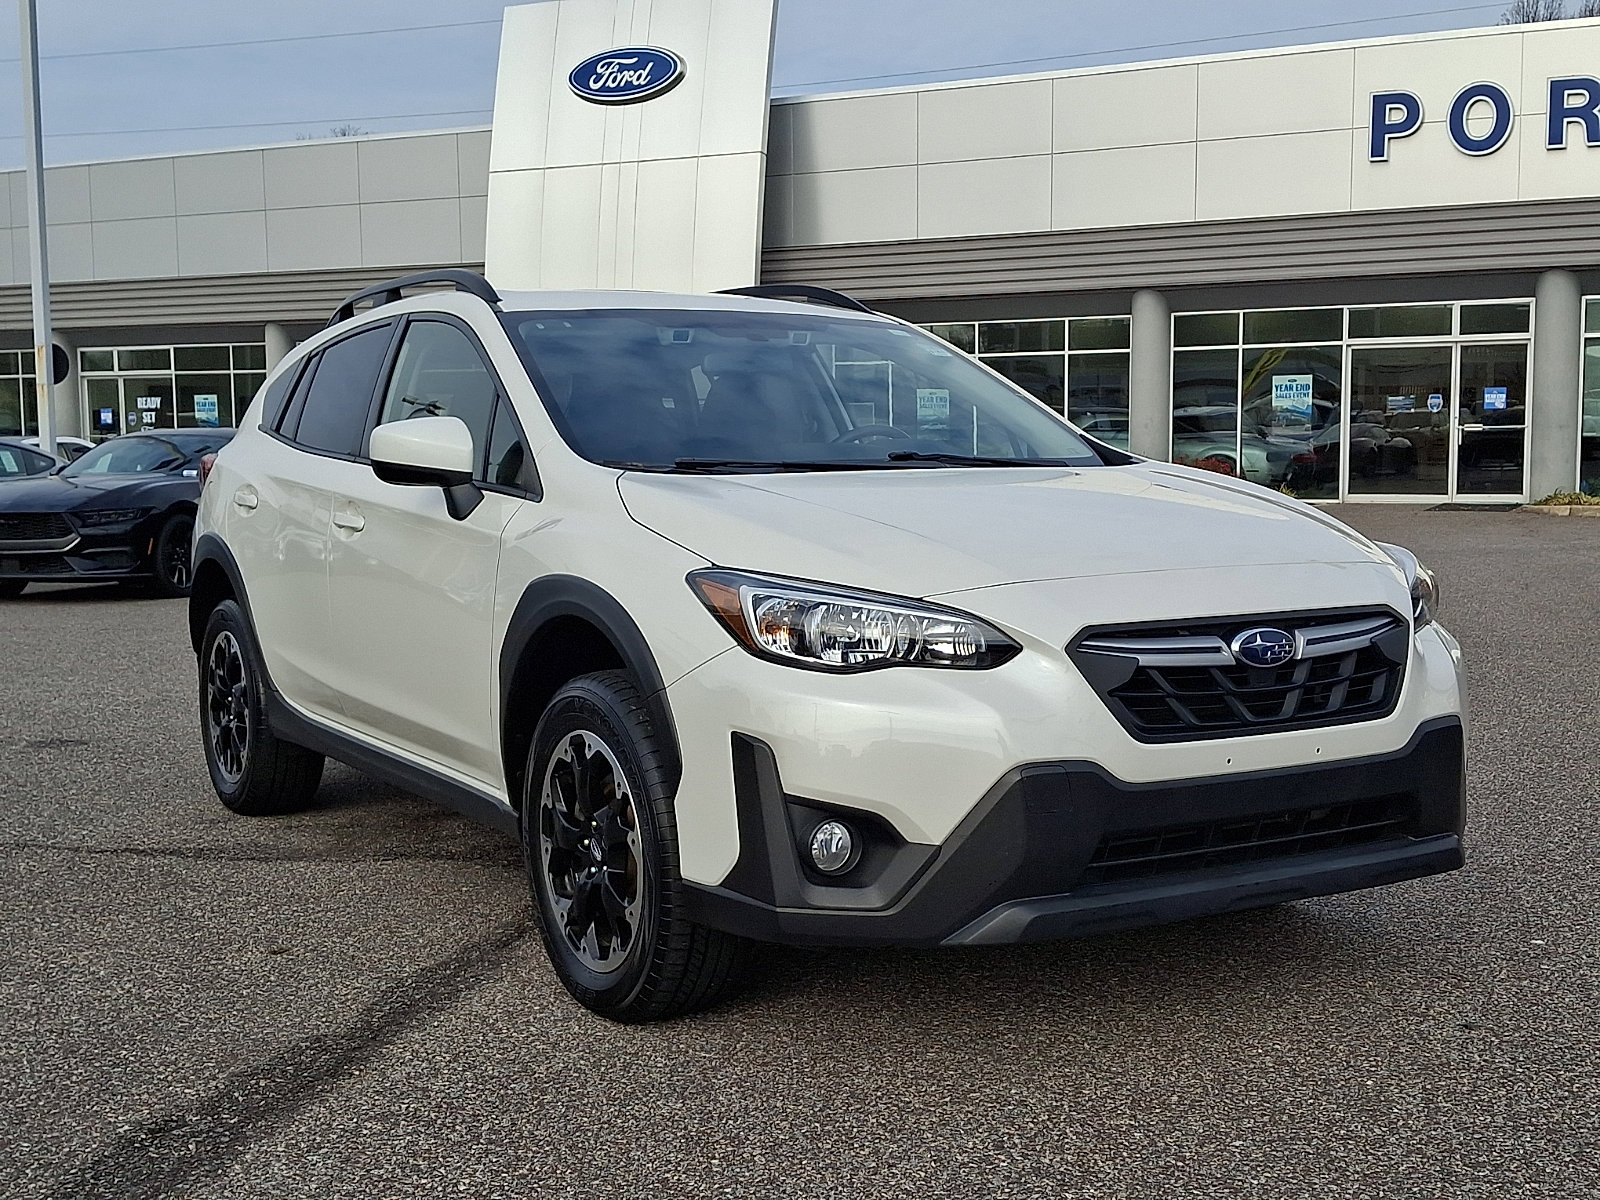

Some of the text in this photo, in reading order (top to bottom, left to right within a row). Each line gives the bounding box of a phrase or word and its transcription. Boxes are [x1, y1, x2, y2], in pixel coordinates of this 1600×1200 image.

[589, 57, 654, 90] Ford
[1369, 75, 1600, 162] POR
[1275, 383, 1310, 392] YEAR END
[137, 397, 161, 409] READY
[142, 411, 155, 424] SET
